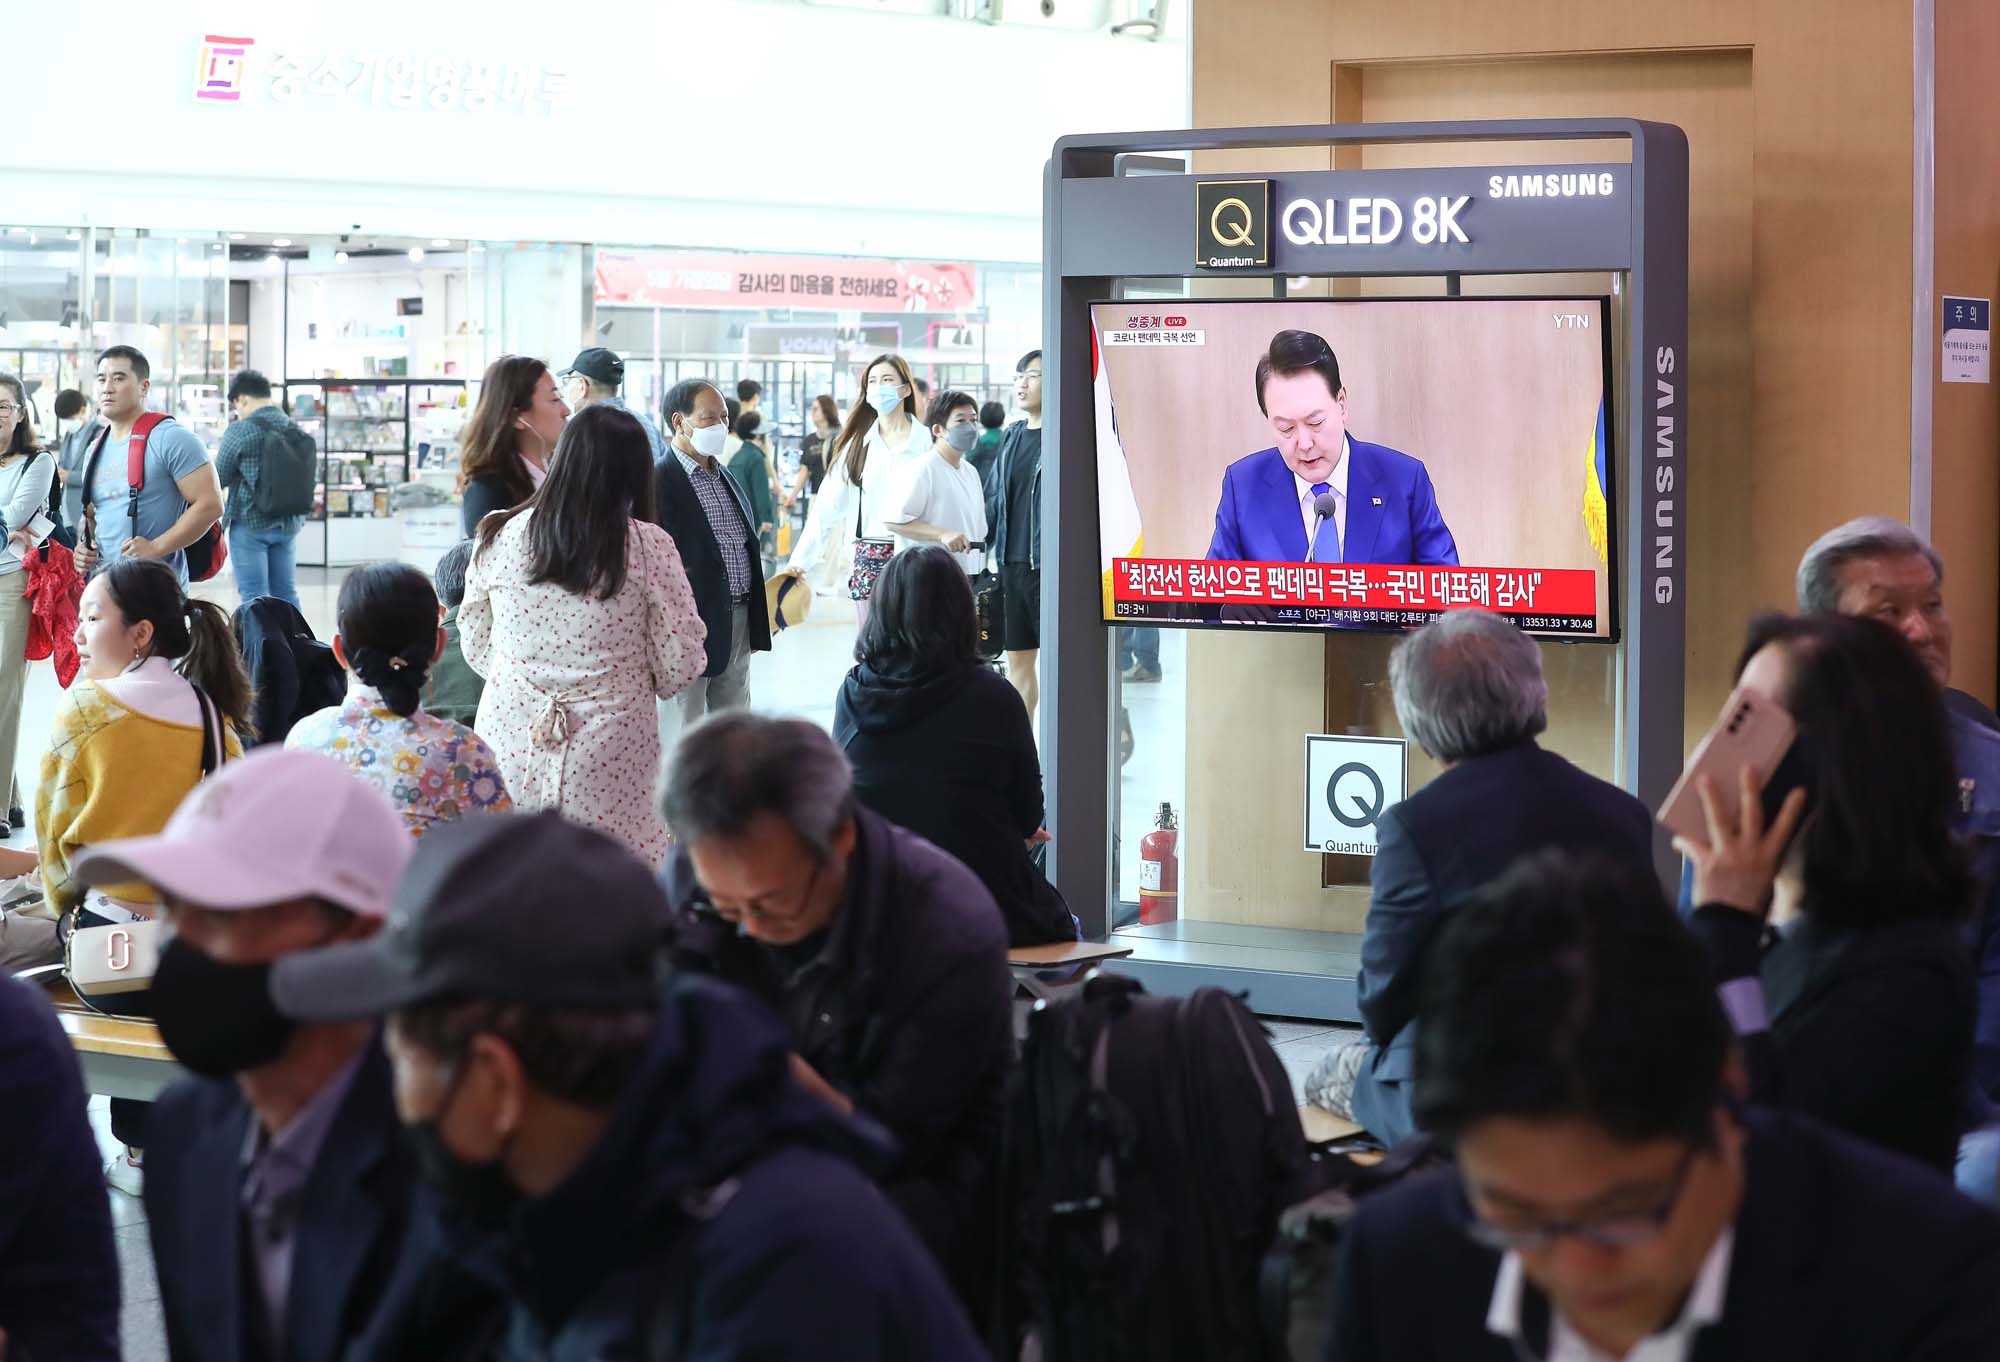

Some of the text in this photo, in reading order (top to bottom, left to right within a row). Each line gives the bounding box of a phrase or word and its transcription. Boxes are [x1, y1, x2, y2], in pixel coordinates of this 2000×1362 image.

[1489, 173, 1614, 198] SAMSUNG
[1210, 198, 1255, 246] Q
[1282, 196, 1470, 245] QLED 8K
[1209, 256, 1254, 268] Quantum
[738, 273, 785, 293] 감사의
[790, 274, 834, 295] 마음을
[840, 277, 898, 298] 전하세요
[1128, 316, 1161, 329] 생중계
[1552, 314, 1589, 329] YTN
[1113, 332, 1196, 343] 코로나 팬데믹 극복 선언
[1655, 346, 1675, 603] SAMSUNG
[1121, 561, 1184, 597] "최전선
[1188, 564, 1264, 598] 헌신으로
[1267, 566, 1324, 601] 팬데믹
[1431, 572, 1490, 606] 대표해
[1495, 572, 1542, 607] 감사"
[1117, 603, 1145, 615] 09:34
[1277, 609, 1302, 618] 스포츠
[1305, 608, 1330, 621] [야구]
[1363, 610, 1378, 623] 9회
[1380, 611, 1399, 623] 대타
[1570, 619, 1593, 629] 30.48
[1327, 762, 1385, 829] Q
